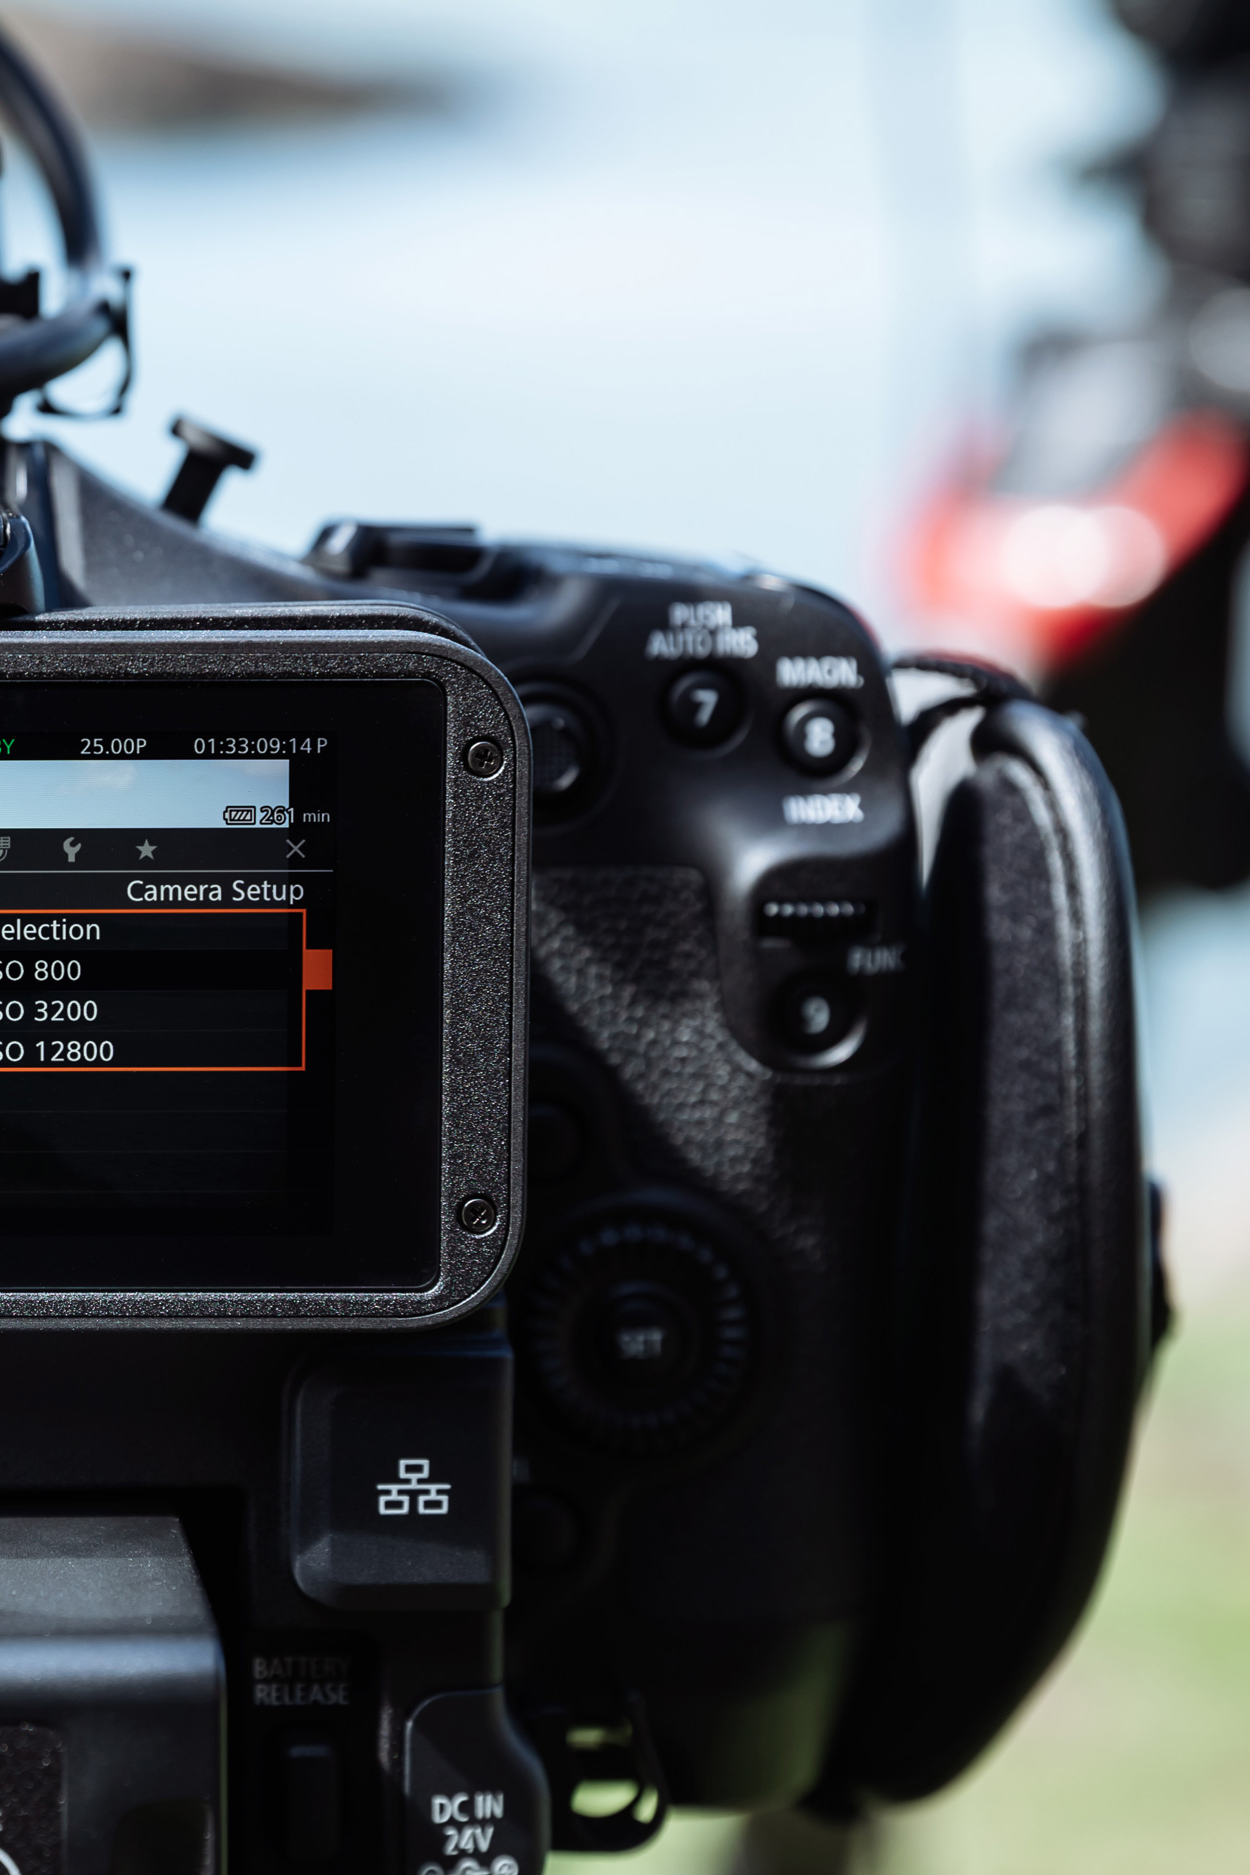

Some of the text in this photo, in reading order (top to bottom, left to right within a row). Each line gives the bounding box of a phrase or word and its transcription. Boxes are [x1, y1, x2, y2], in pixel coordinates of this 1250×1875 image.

[668, 601, 733, 627] PUSH
[646, 627, 713, 659] AUTO
[691, 688, 719, 727] 7
[80, 738, 147, 755] 25.00P
[804, 716, 836, 757] 8
[260, 806, 330, 825] 261 min
[782, 792, 864, 824] INDEX
[126, 880, 305, 904] Camera Setup
[34, 960, 82, 981] 800
[34, 1001, 98, 1022] 3200
[800, 996, 831, 1034] 9
[34, 1041, 115, 1062] 12800
[252, 1655, 351, 1680] BATTERY
[252, 1681, 350, 1706] RELEASE
[431, 1790, 504, 1824] DC IN
[442, 1823, 495, 1856] 24V
